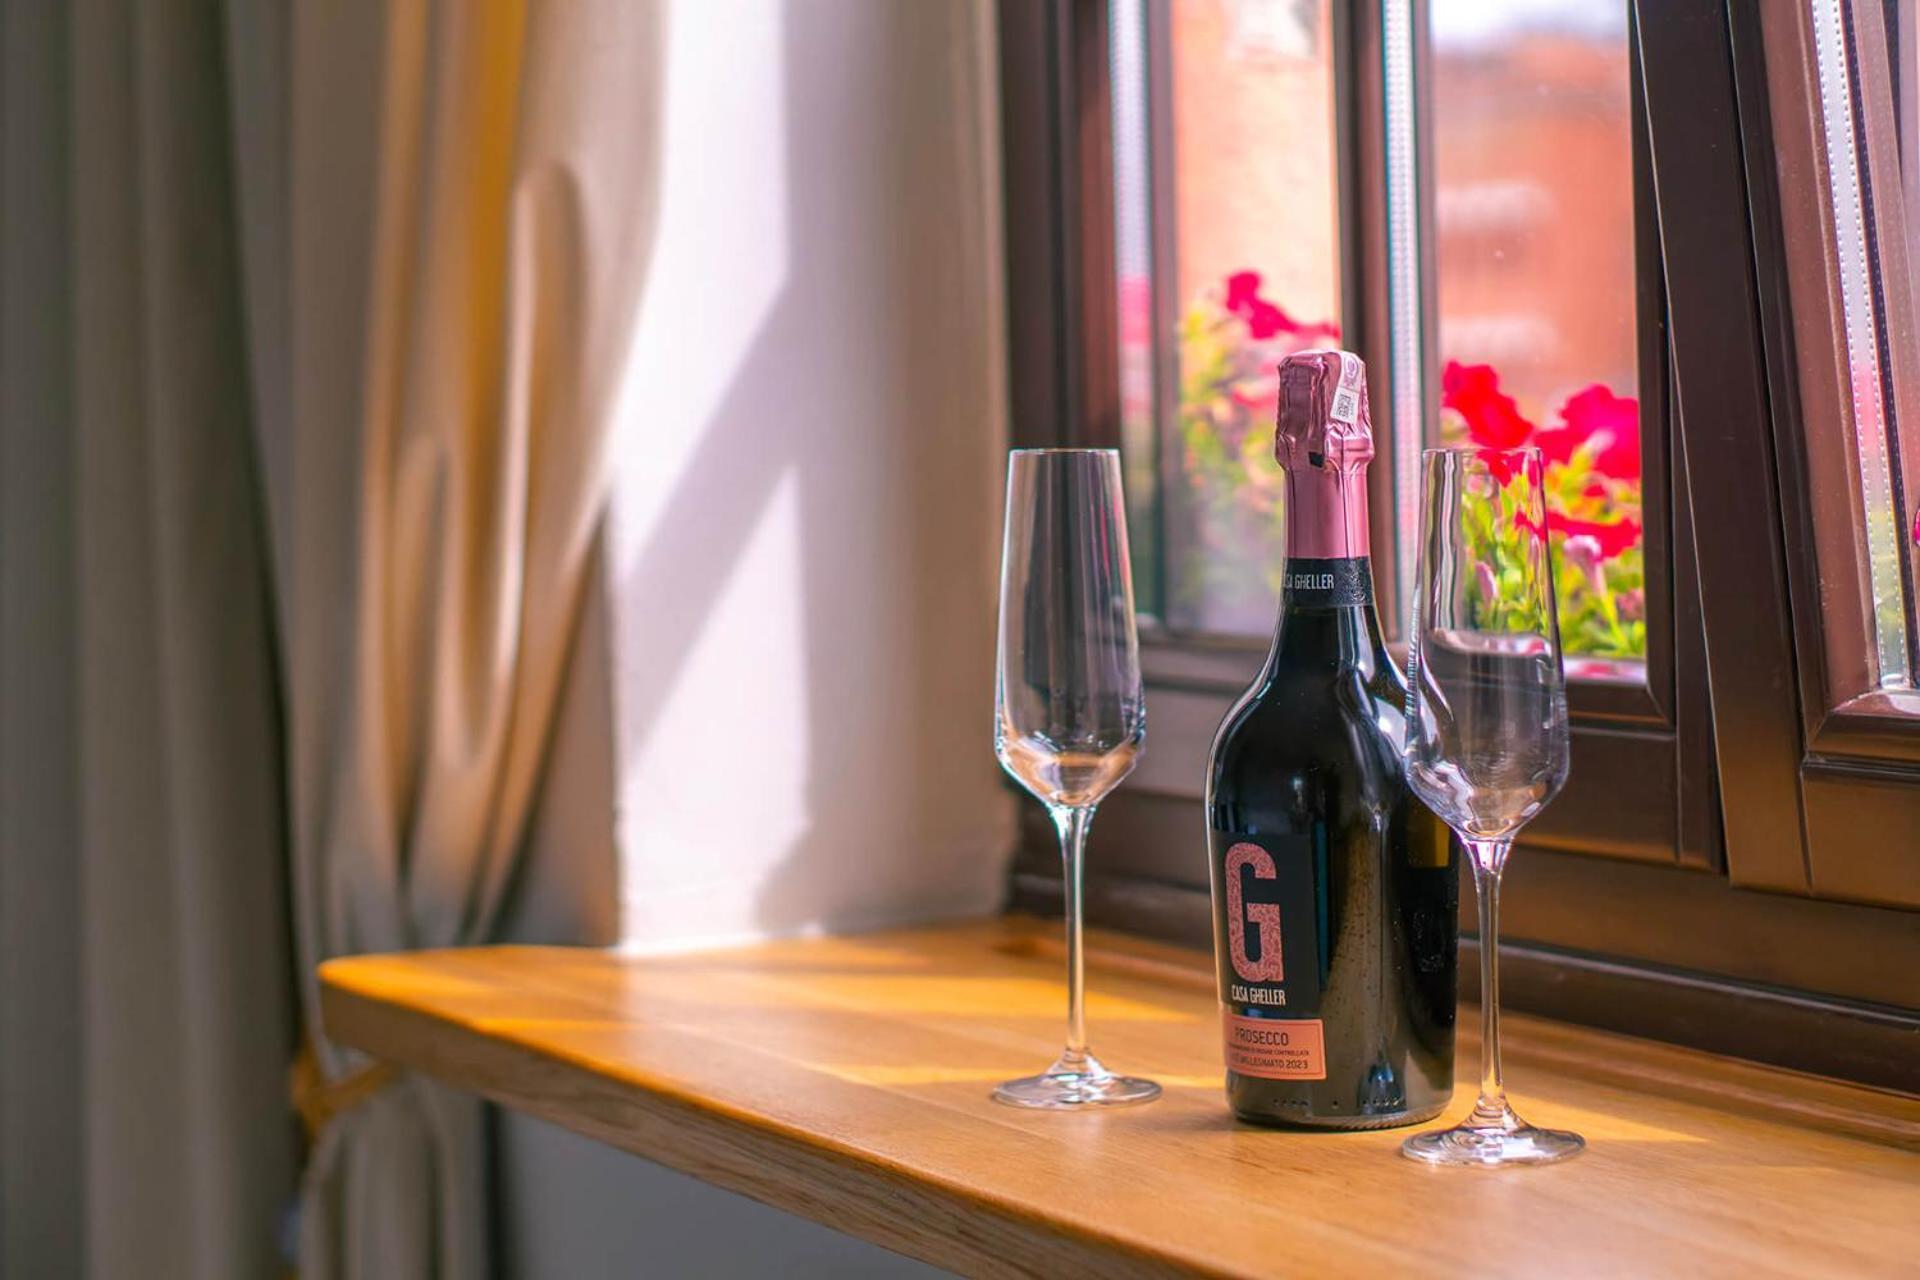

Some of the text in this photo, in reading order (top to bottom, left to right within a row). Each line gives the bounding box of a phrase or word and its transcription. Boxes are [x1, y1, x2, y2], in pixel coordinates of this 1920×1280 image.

[1295, 574, 1335, 589] GHELLER
[1224, 841, 1284, 983] G
[1231, 984, 1286, 1006] CASA GHELLER
[1235, 1025, 1289, 1046] PROSECCO
[1286, 1059, 1308, 1069] 2023
